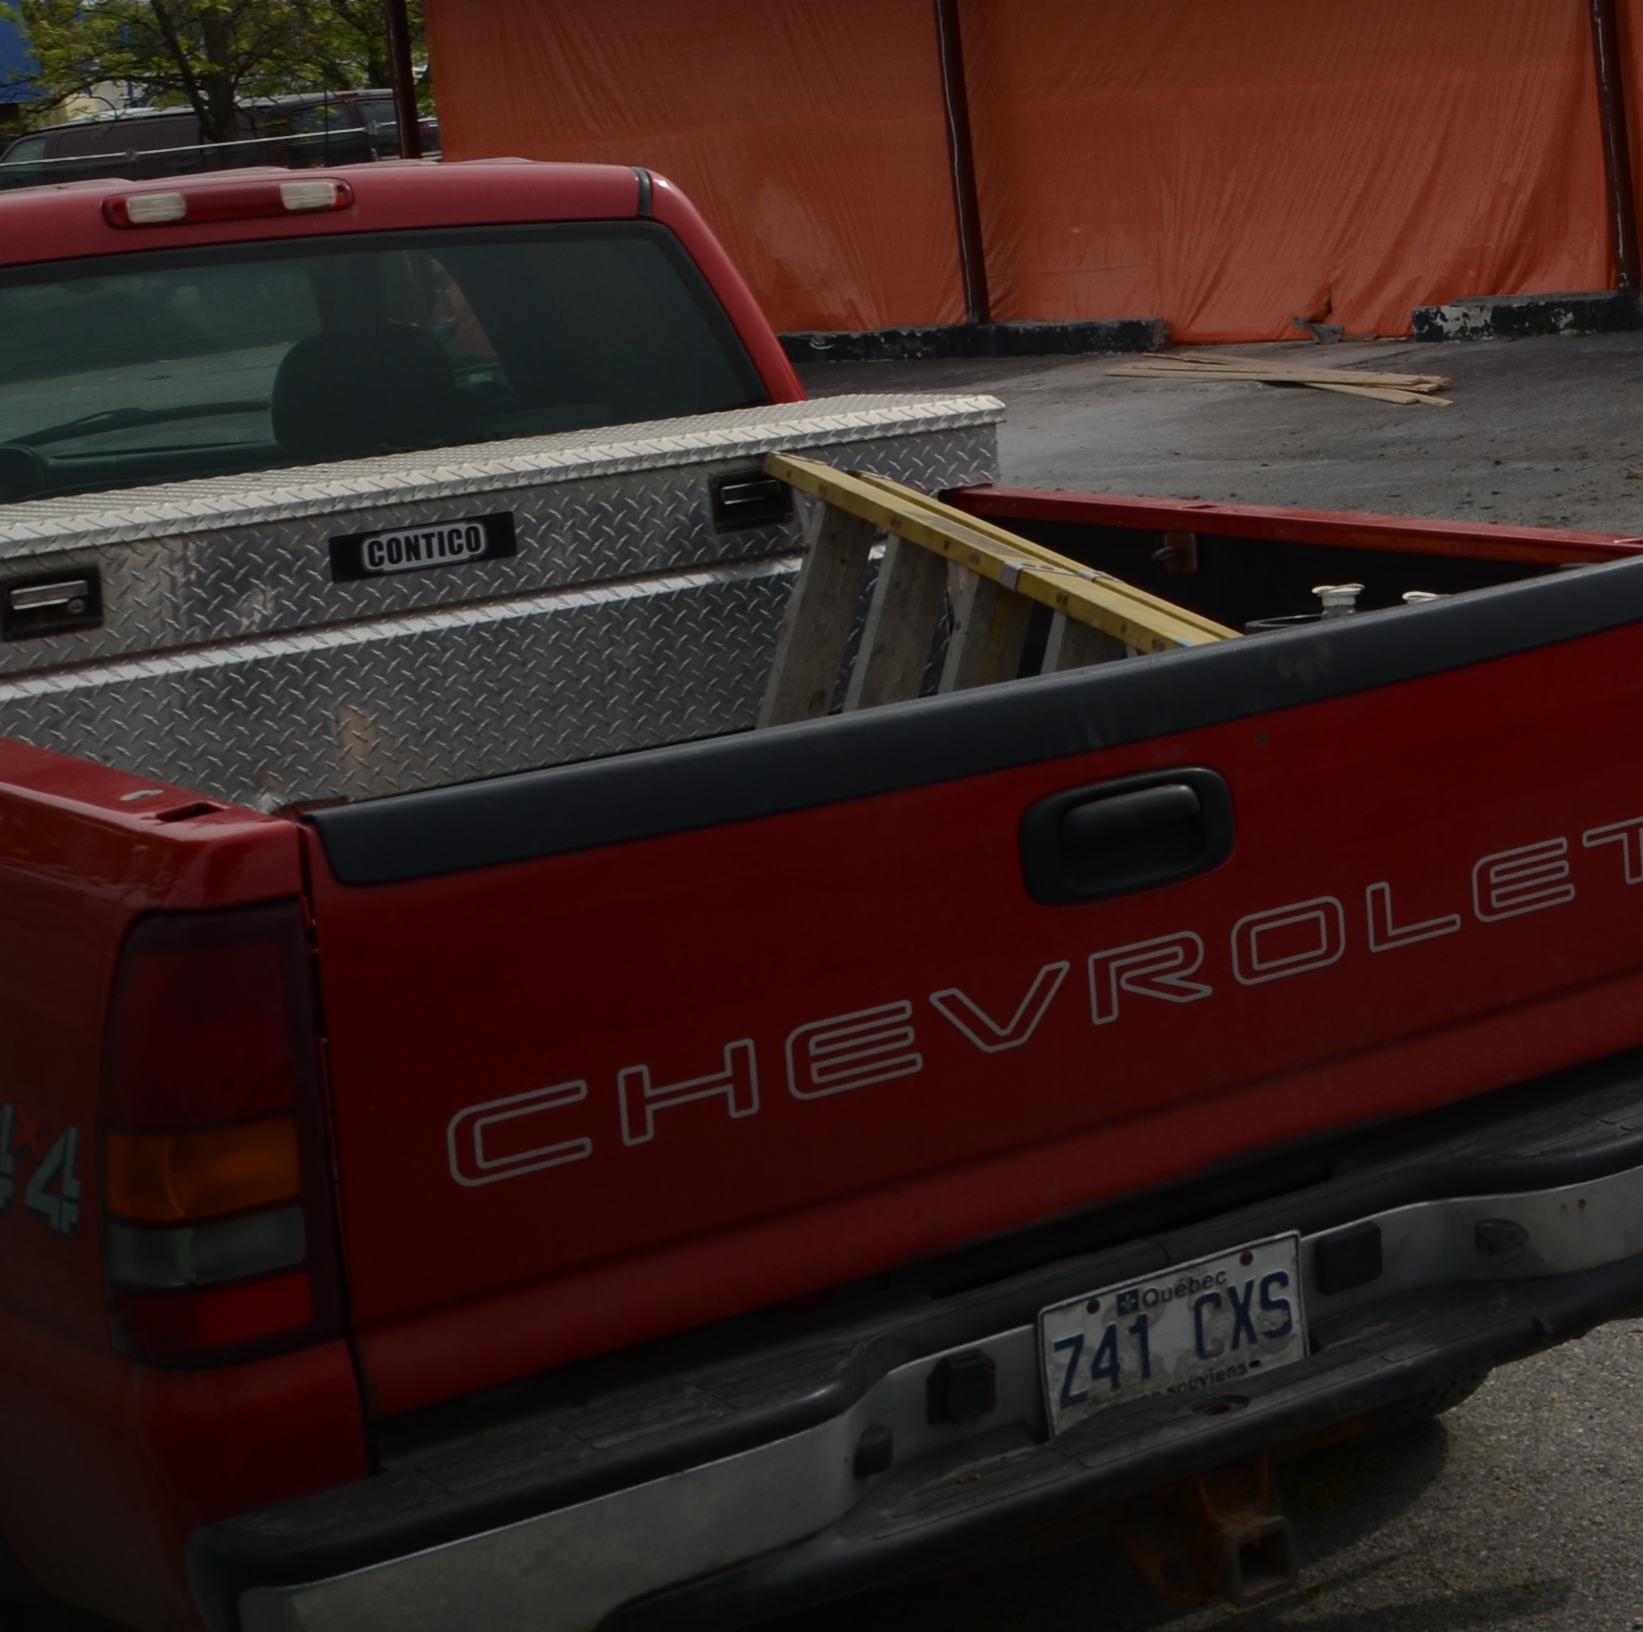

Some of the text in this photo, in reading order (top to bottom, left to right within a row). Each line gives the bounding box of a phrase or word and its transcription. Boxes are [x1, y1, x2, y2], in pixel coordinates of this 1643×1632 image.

[367, 524, 483, 568] CONTICO
[1142, 1270, 1228, 1308] Québec
[1193, 1270, 1293, 1361] CXS
